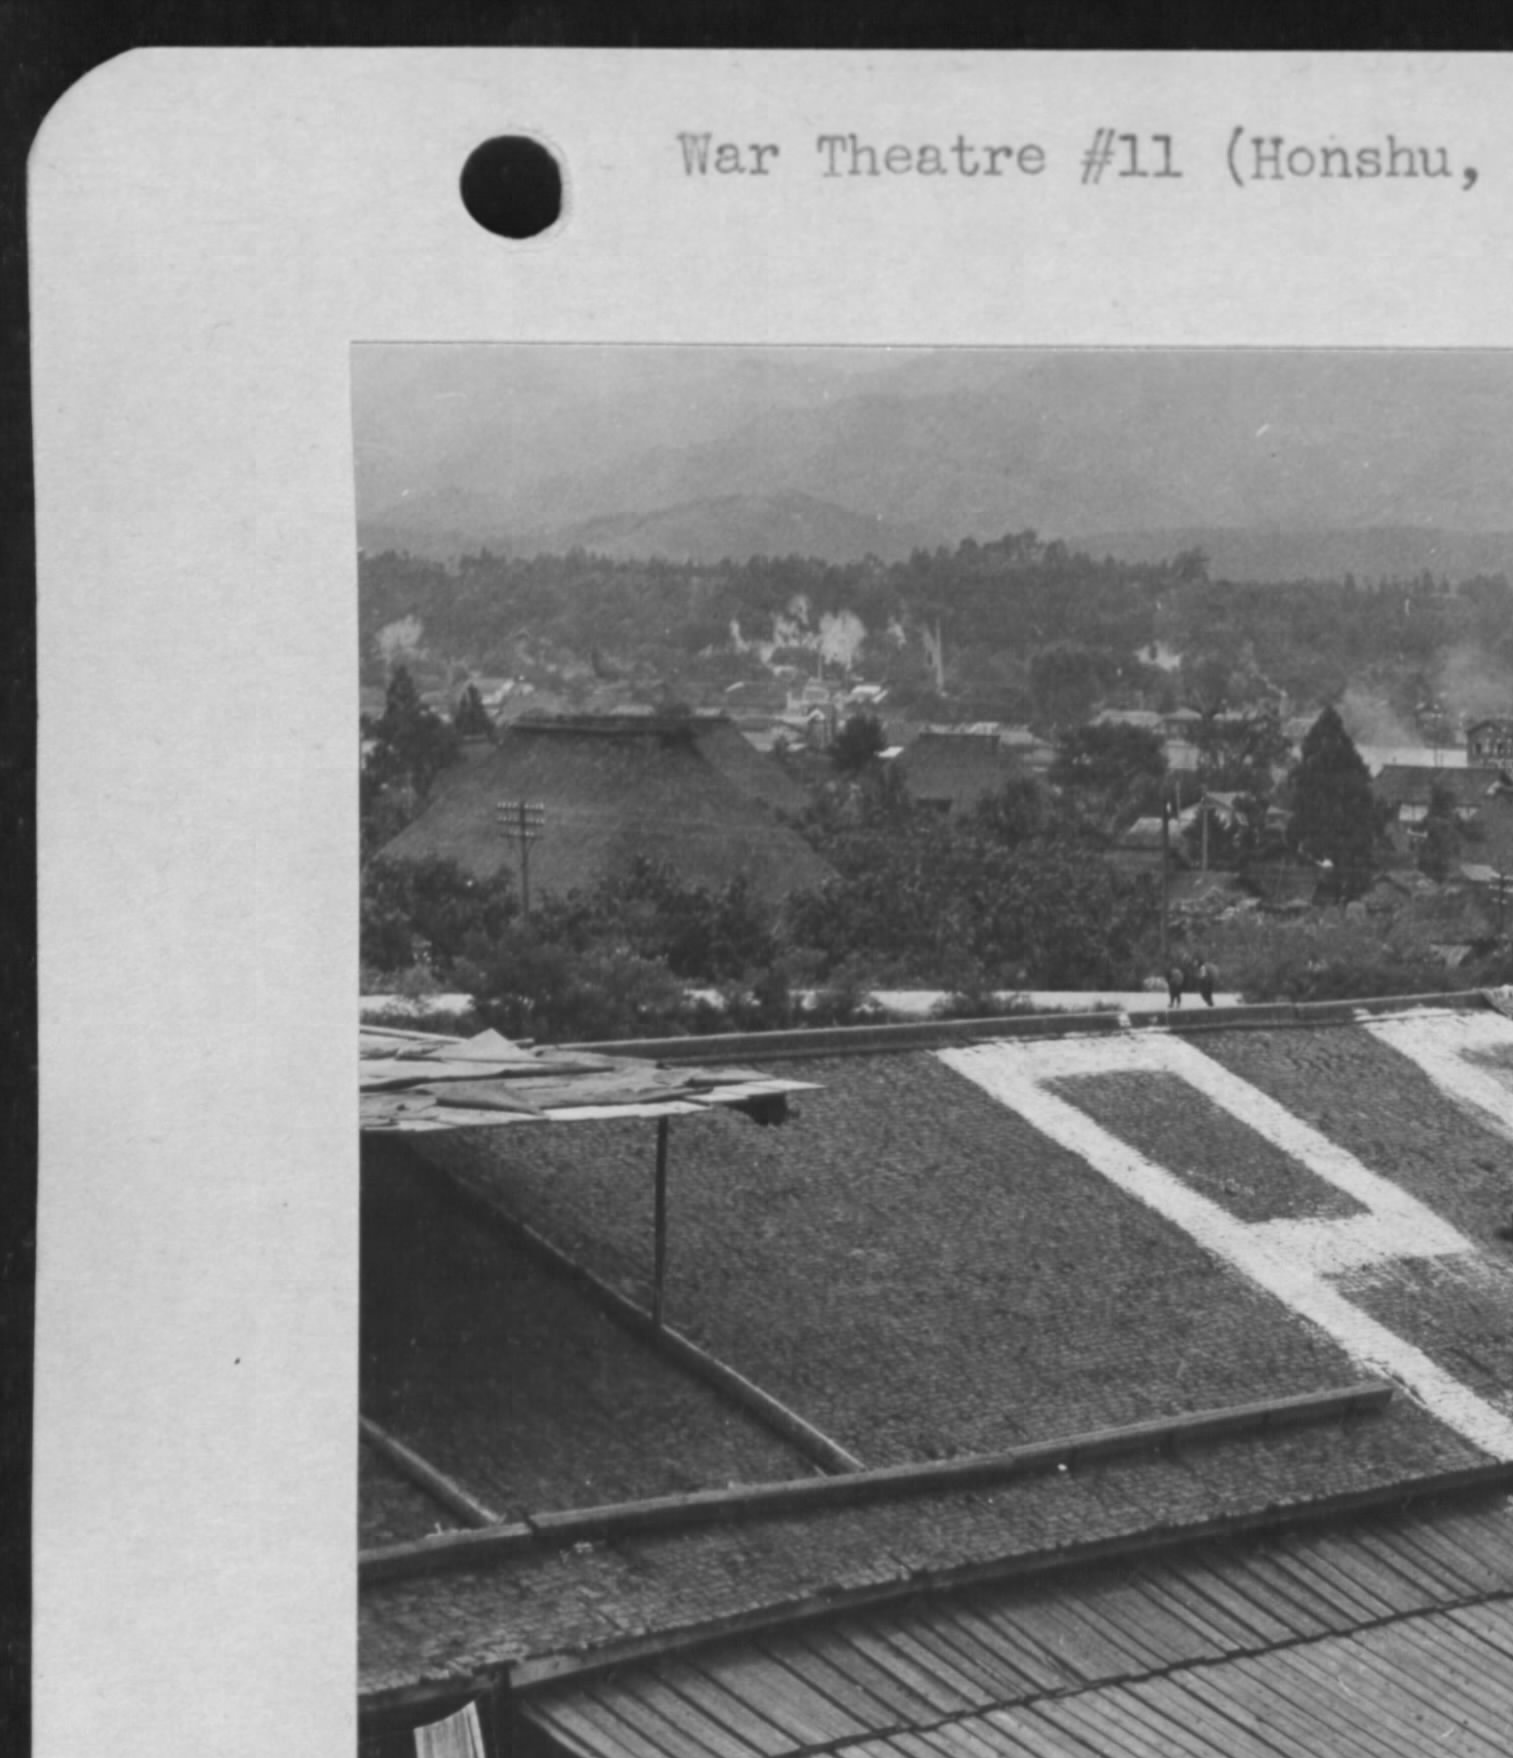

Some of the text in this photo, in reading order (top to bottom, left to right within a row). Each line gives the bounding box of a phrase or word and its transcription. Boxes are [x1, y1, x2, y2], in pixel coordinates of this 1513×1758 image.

[675, 131, 780, 176] War
[815, 132, 1045, 177] Theatre
[1080, 126, 1184, 184] #11
[1226, 125, 1480, 190] (Honshu,
